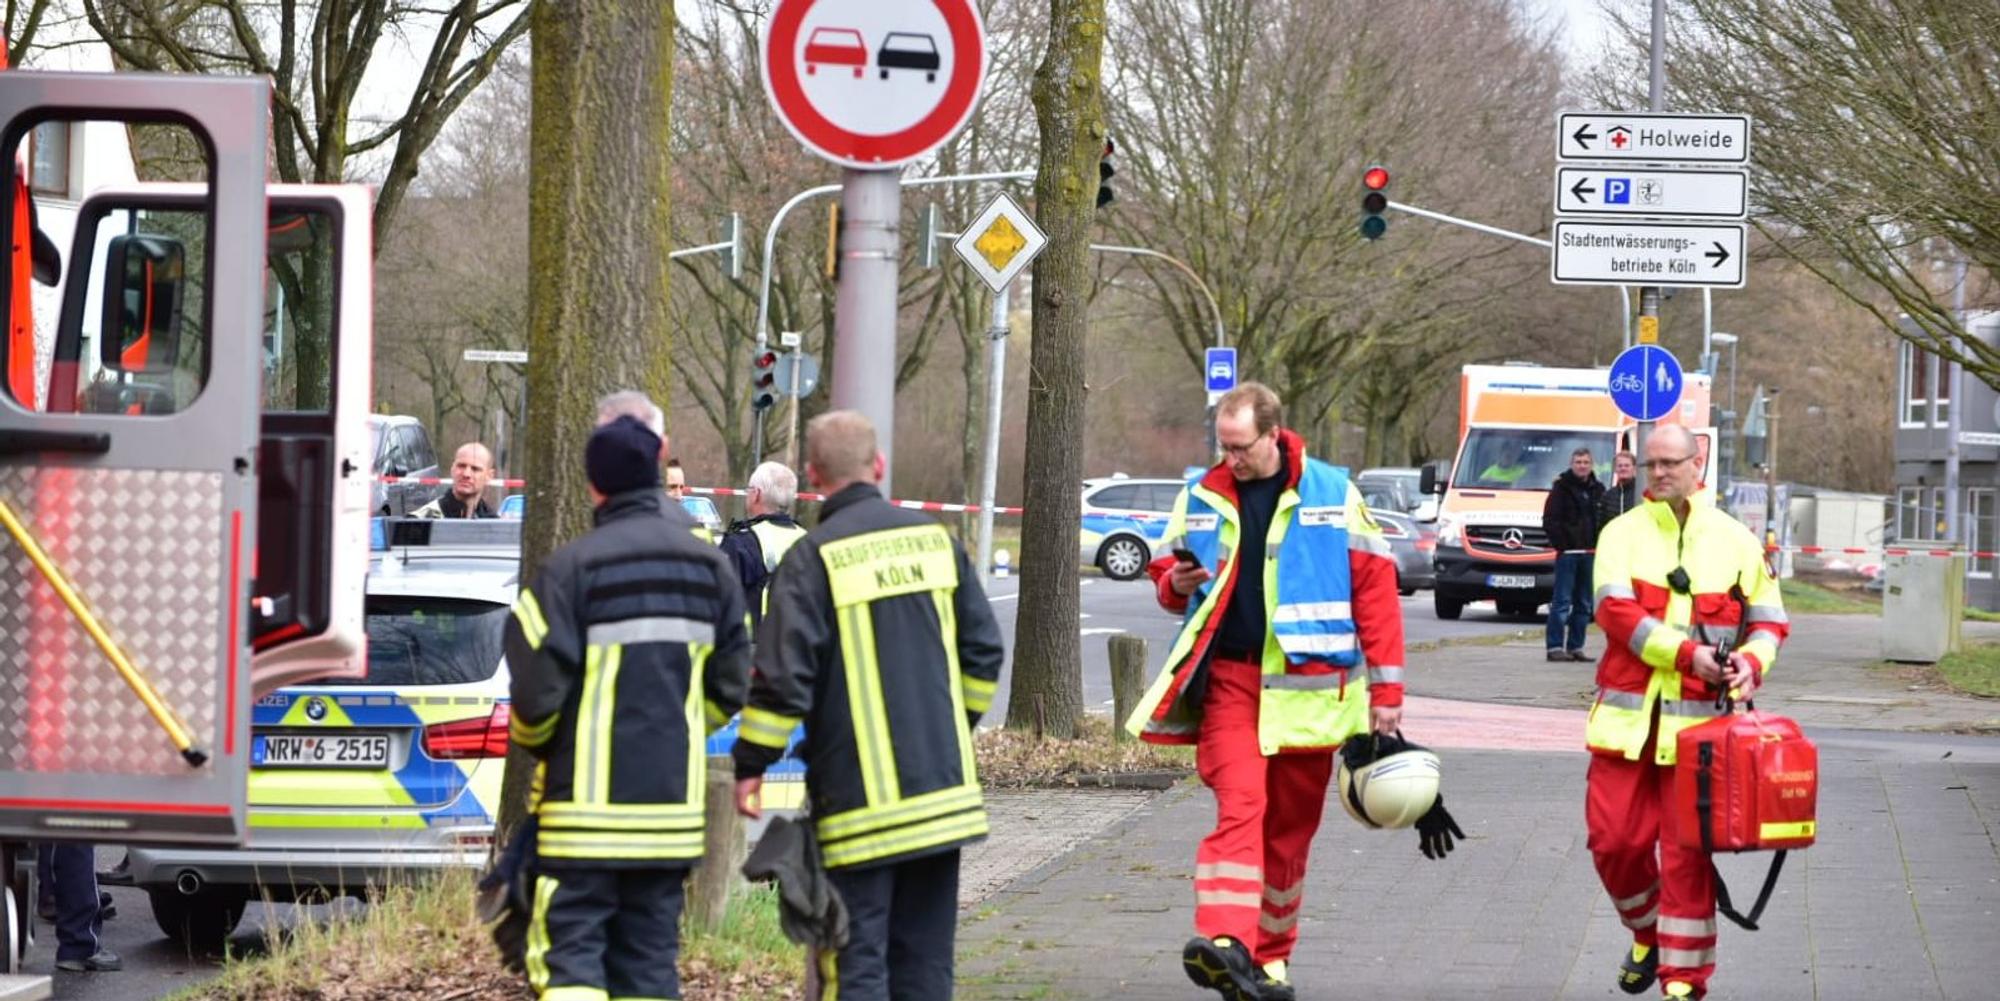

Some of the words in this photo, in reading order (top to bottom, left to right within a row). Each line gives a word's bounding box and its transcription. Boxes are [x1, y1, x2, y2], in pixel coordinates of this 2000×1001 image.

[1640, 129, 1733, 148] Holweide
[1610, 181, 1625, 200] P
[1562, 232, 1697, 253] Stadtentwässerungs-
[1611, 257, 1663, 274] betriebe
[1668, 258, 1696, 274] Köln
[829, 533, 947, 570] BERUFSFEUERWEHR
[874, 562, 925, 590] KÖLN
[264, 739, 303, 761] NRW
[313, 739, 386, 761] 6-2515
